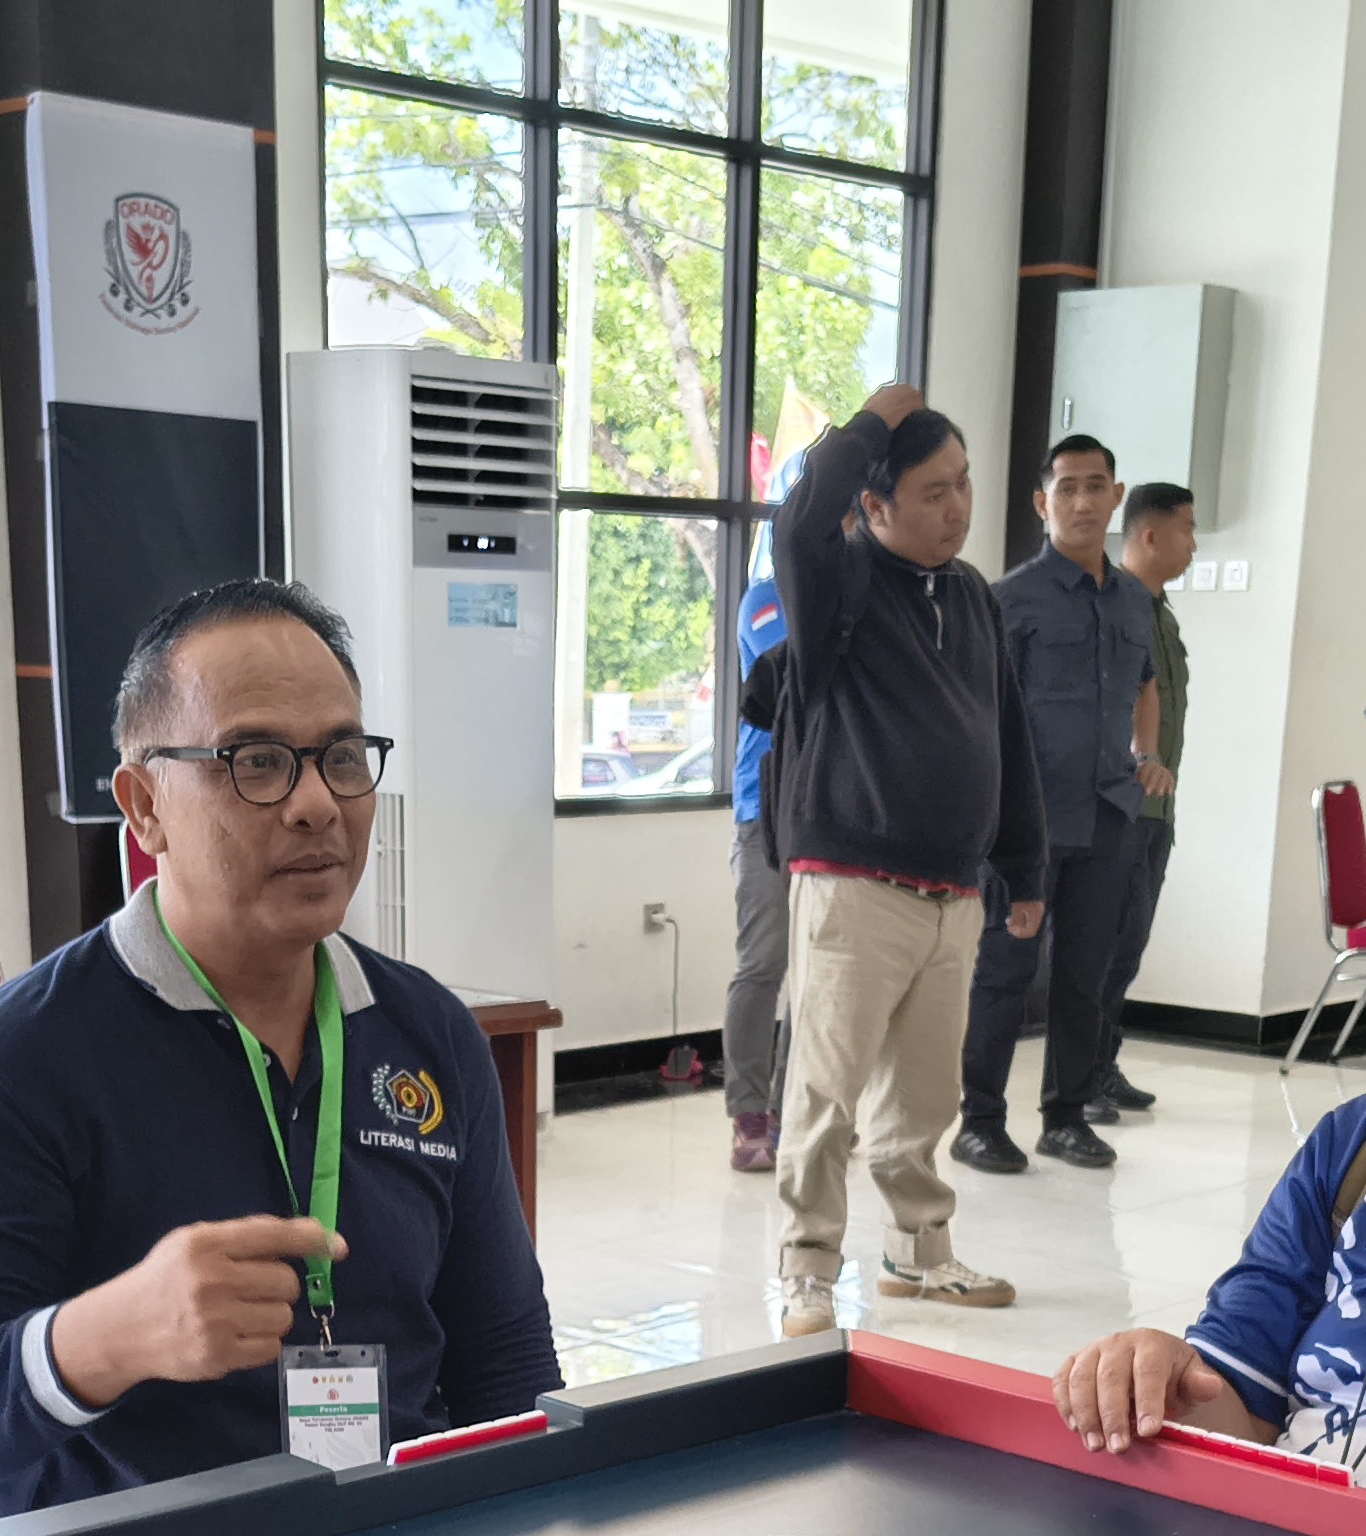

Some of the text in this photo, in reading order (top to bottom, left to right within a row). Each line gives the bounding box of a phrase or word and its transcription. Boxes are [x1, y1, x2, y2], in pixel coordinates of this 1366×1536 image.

[360, 1129, 457, 1161] LITERASI MEDIA
[320, 1406, 347, 1414] Peserta
